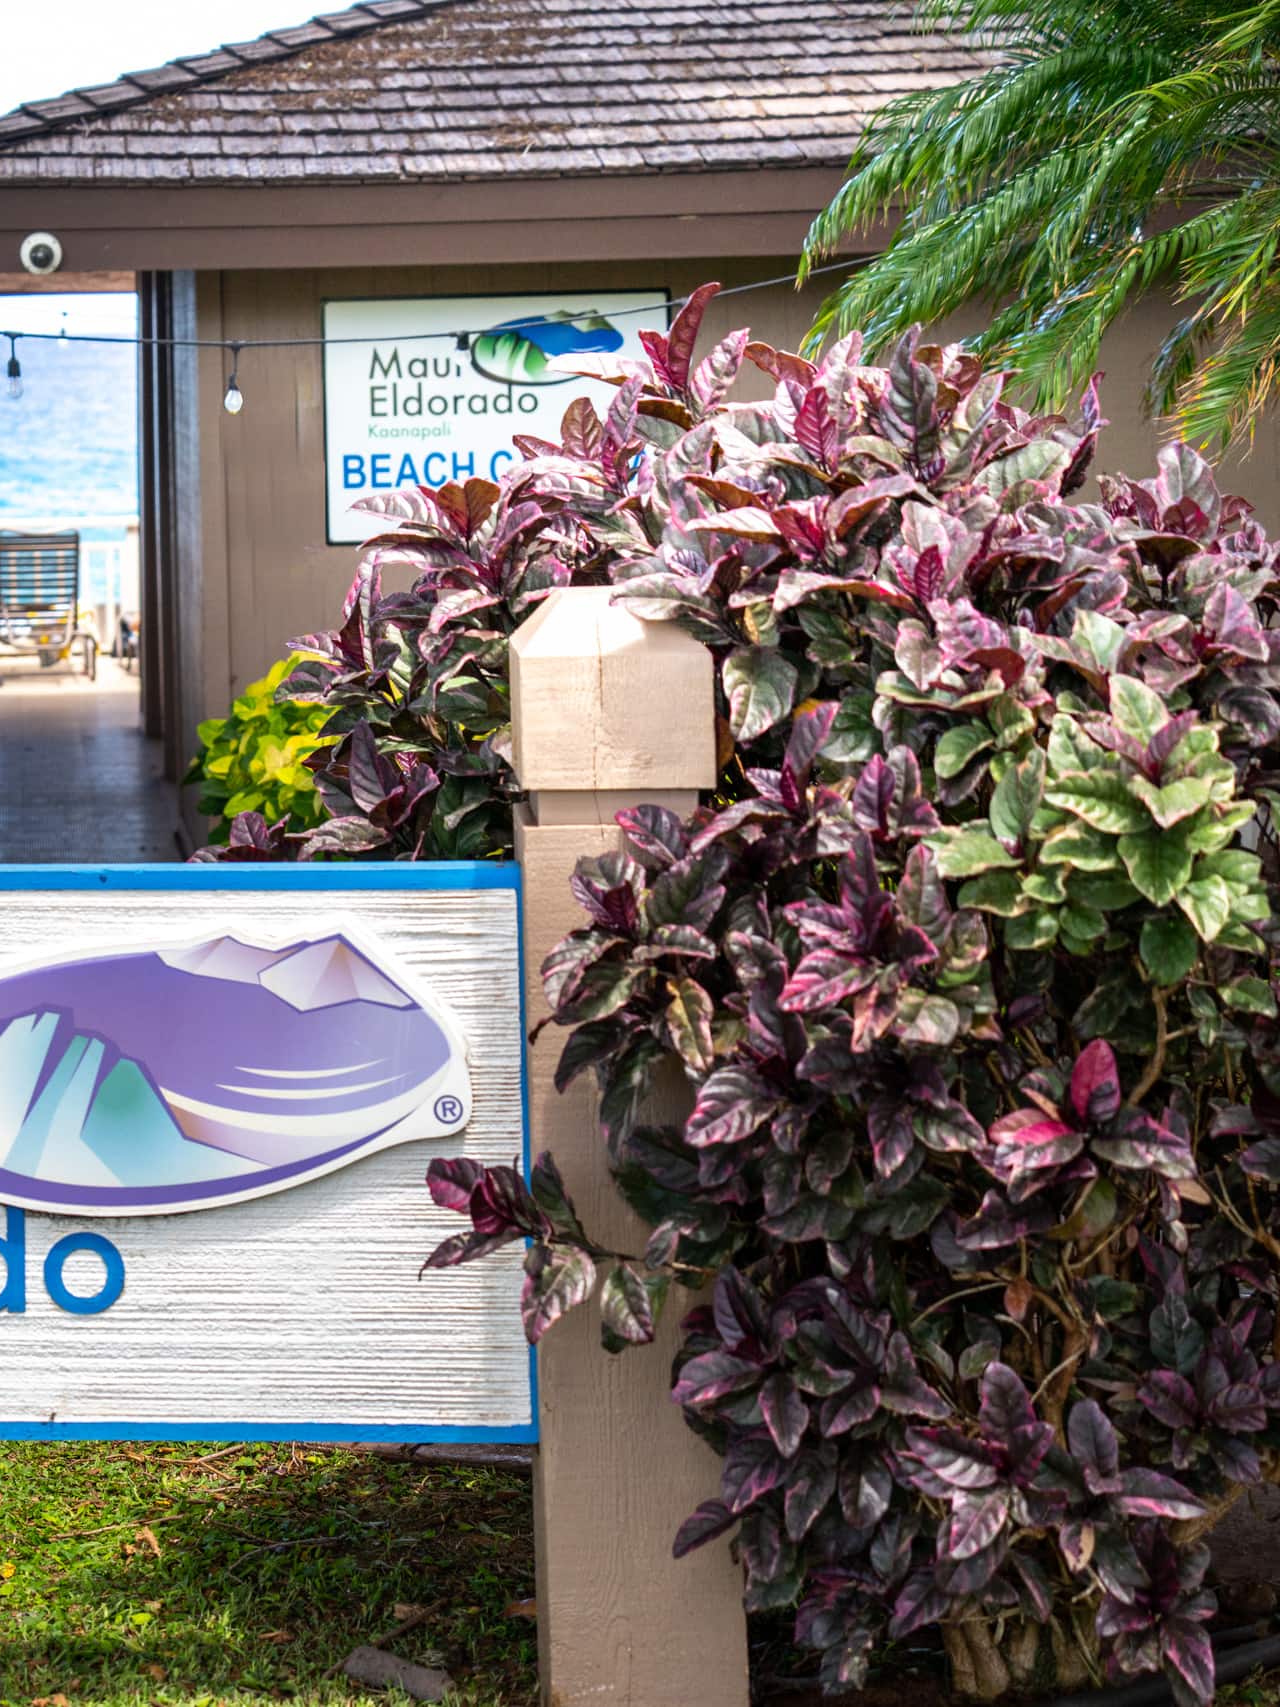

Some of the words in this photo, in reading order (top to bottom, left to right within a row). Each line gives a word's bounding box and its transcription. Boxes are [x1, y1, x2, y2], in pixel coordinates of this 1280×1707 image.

[369, 382, 539, 418] Eldorado
[368, 420, 452, 441] Kaanapali
[342, 451, 475, 489] BEACH
